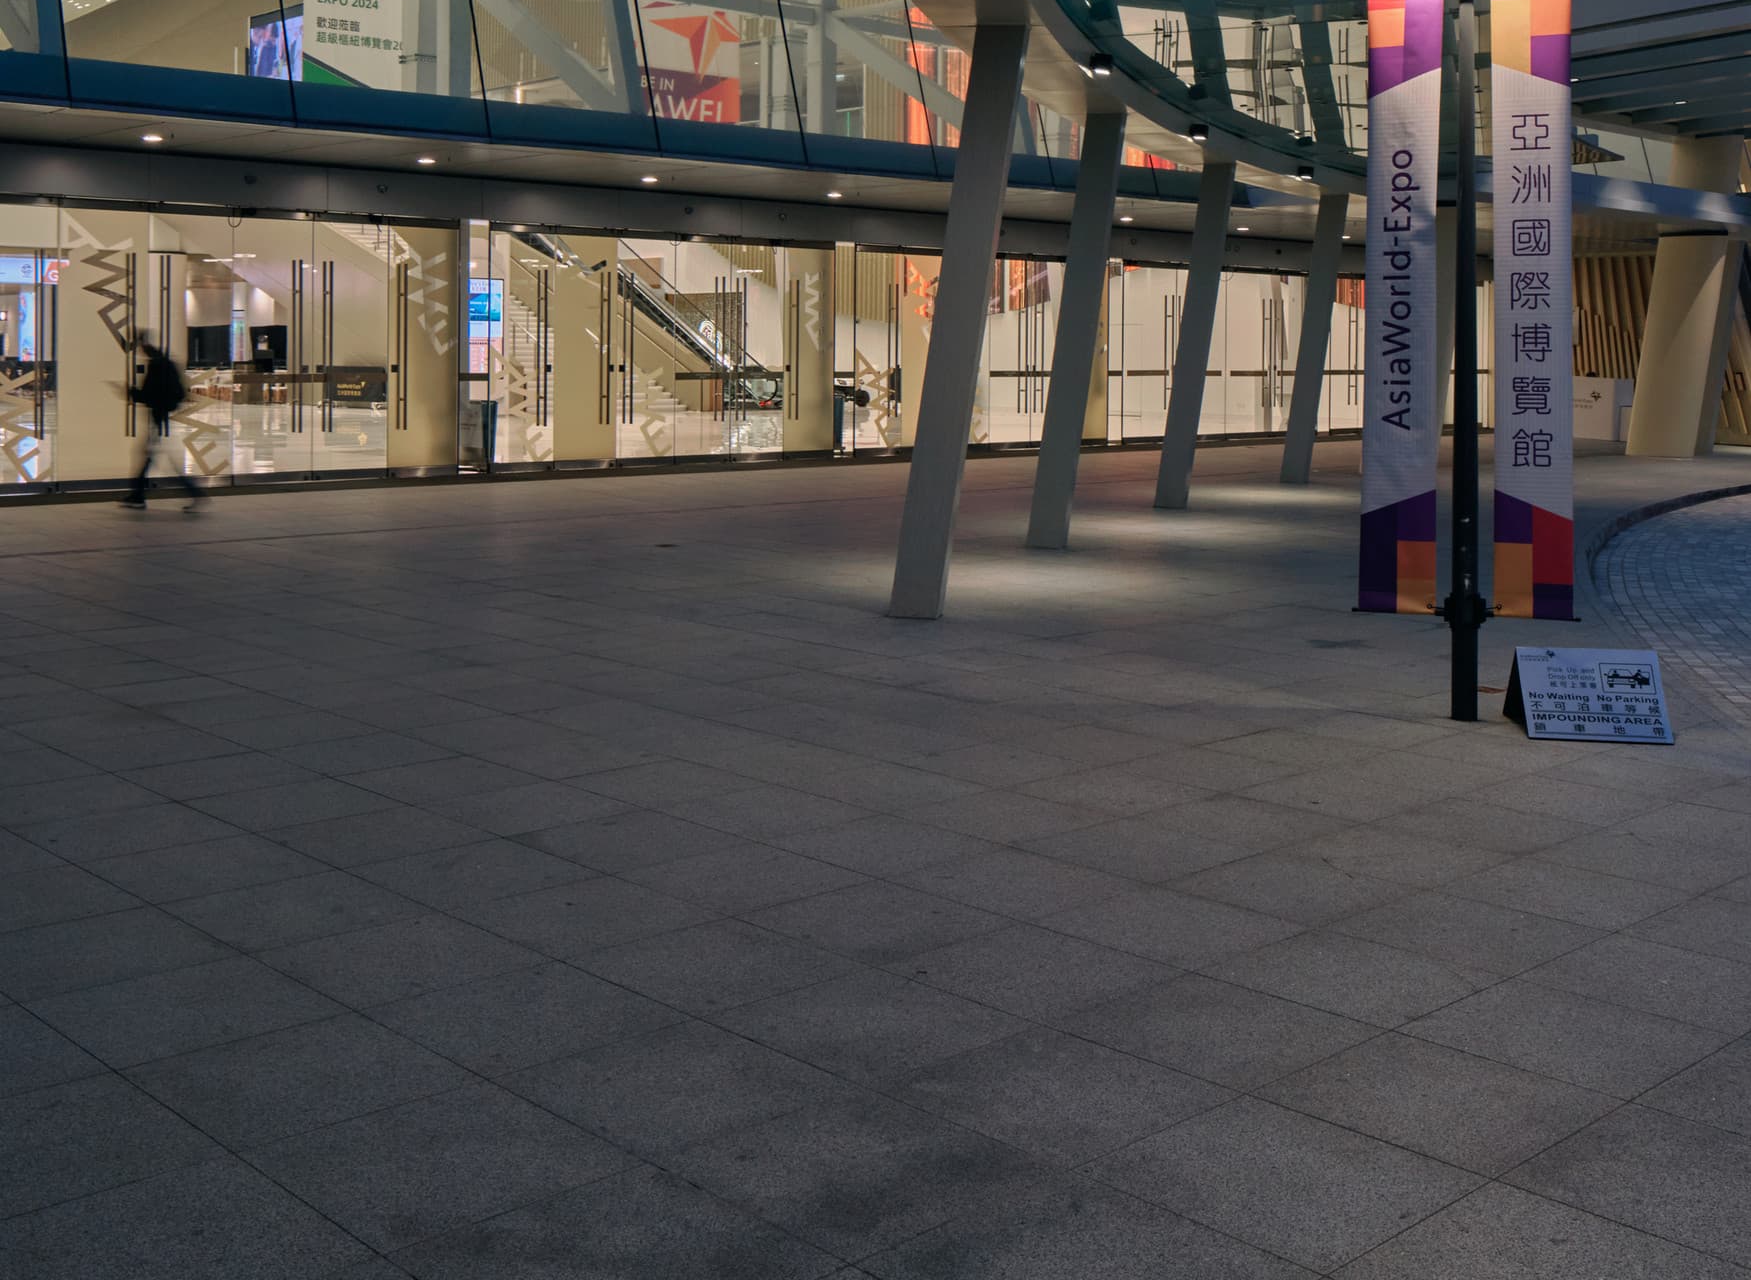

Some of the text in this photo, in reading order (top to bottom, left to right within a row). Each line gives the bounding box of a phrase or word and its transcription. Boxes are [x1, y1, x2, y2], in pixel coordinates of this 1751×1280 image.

[641, 74, 675, 91] BE IN
[1381, 149, 1420, 431] AsiaWorld-Expo
[1510, 113, 1553, 468] 亞洲國際博覽館
[1529, 692, 1660, 705] No Waiting No Parking
[1532, 713, 1663, 726] IMPOUNDING AREA
